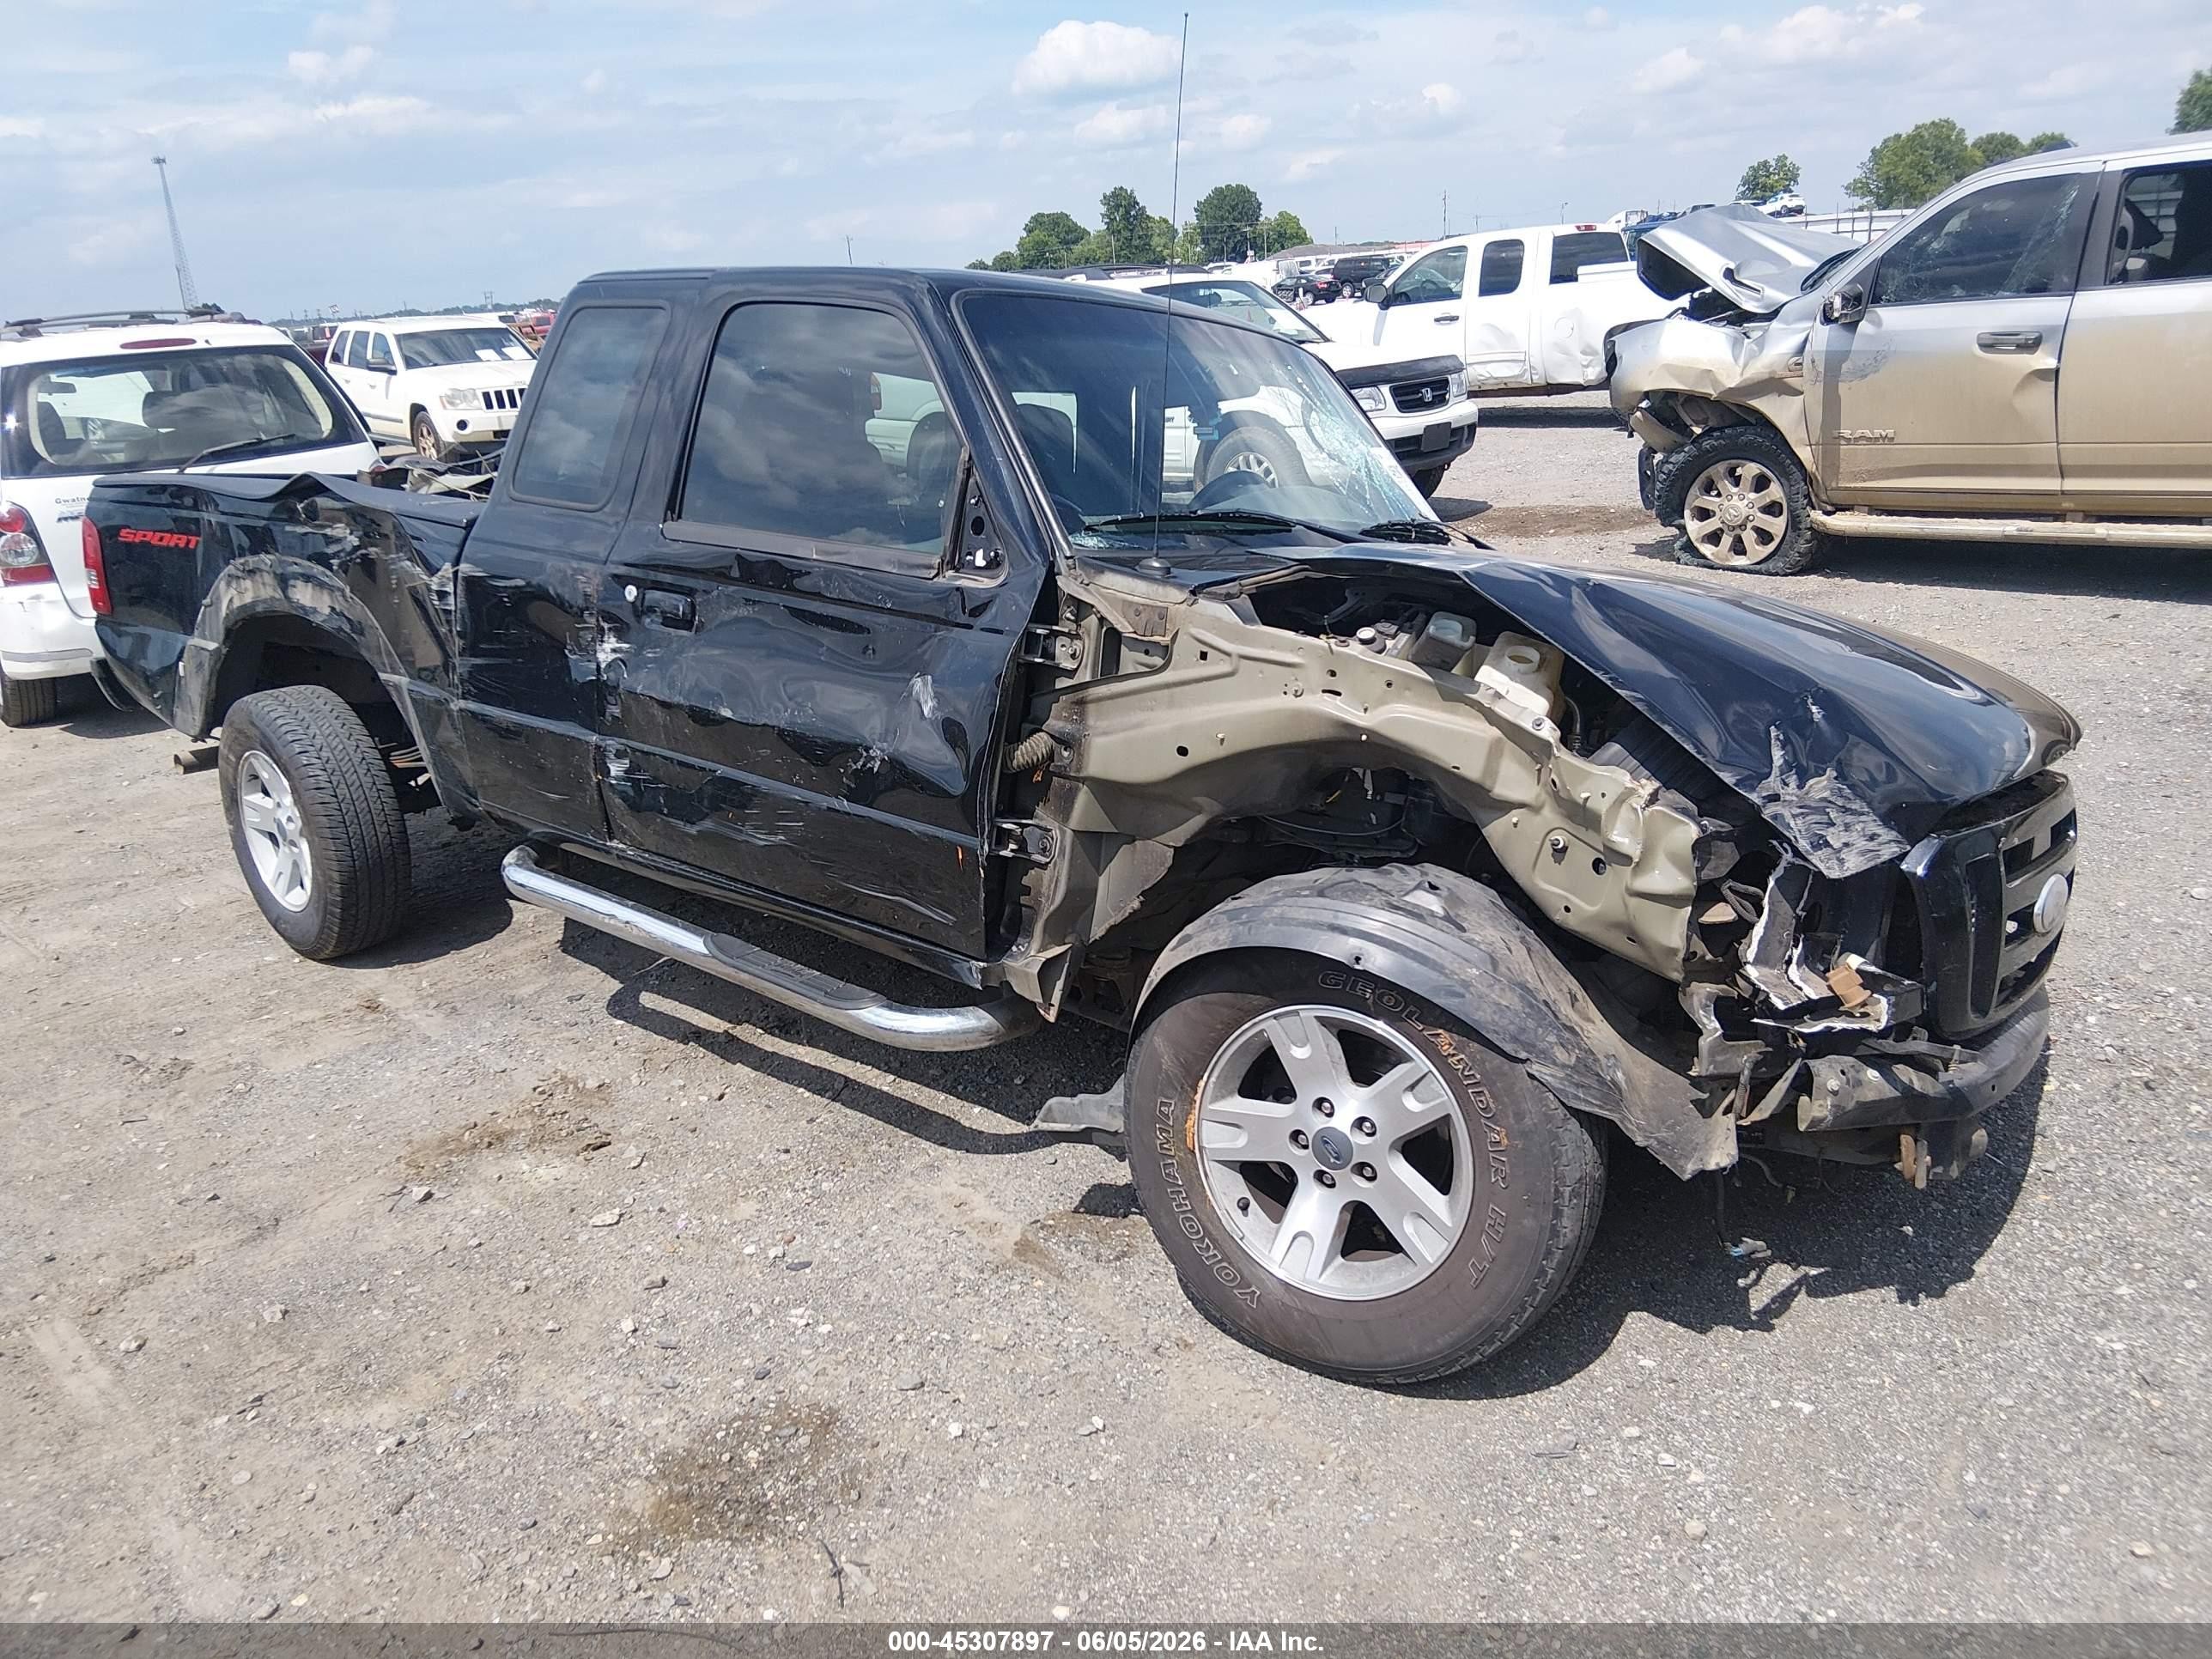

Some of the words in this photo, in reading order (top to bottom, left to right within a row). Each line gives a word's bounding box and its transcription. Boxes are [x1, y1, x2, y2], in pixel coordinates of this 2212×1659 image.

[1833, 429, 1894, 441] RAM
[118, 528, 200, 549] SPORT
[1318, 971, 1509, 1189] GEOLANDAR
[1468, 1203, 1507, 1289] H/T
[1155, 1098, 1261, 1309] YOKOHAMA
